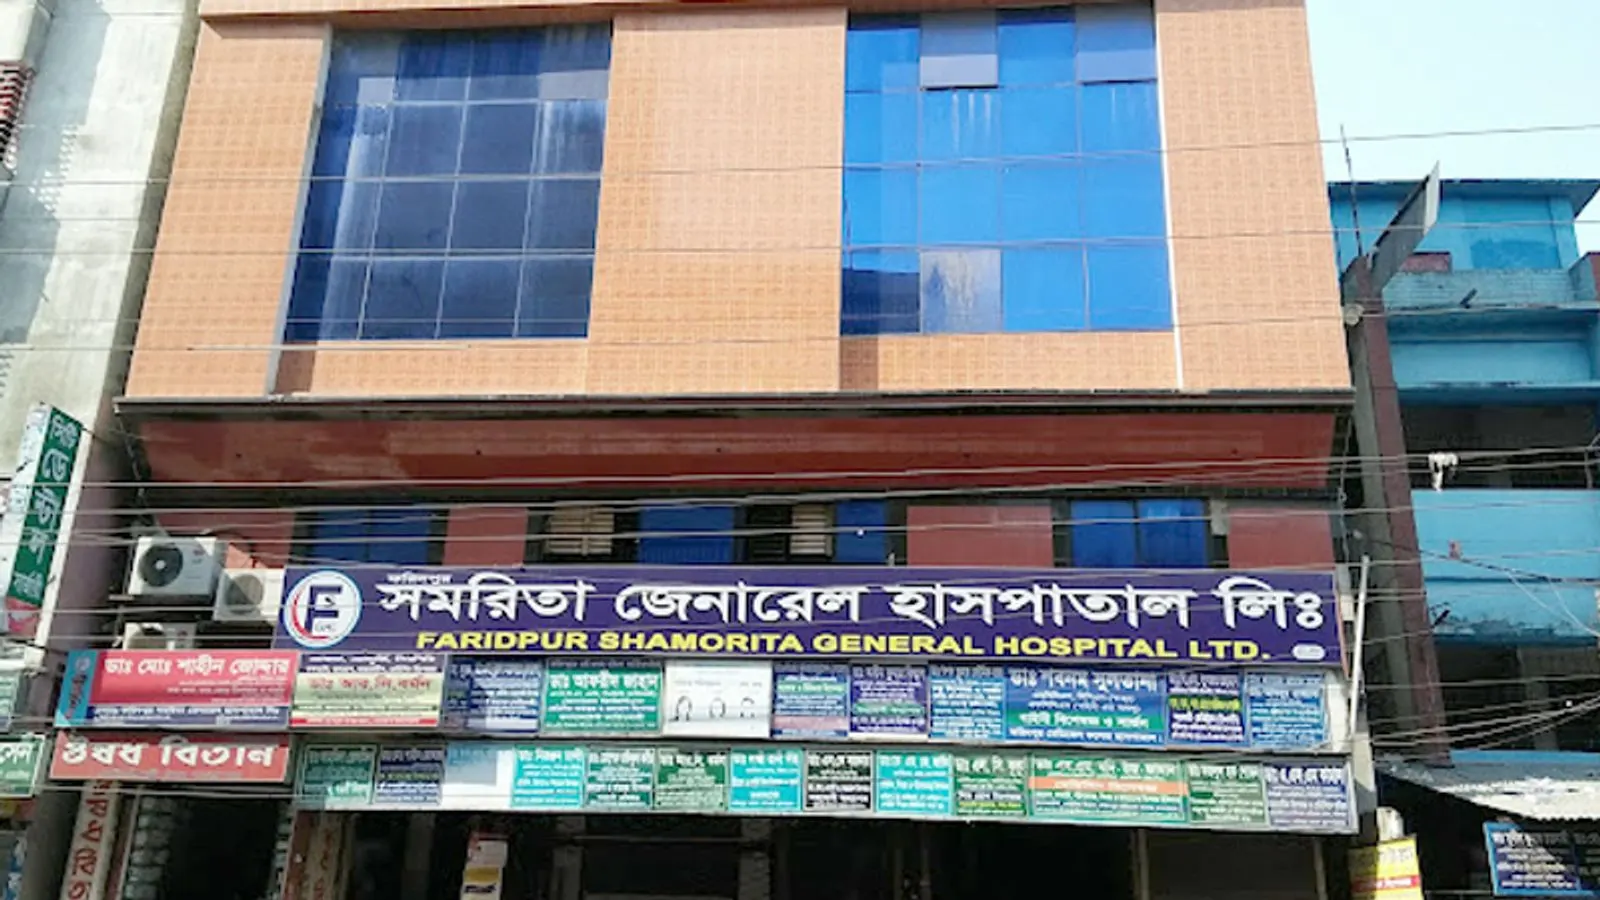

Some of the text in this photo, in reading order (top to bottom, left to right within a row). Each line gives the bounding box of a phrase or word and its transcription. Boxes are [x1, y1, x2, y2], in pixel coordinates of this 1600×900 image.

[375, 574, 1324, 629] সমরিতা জেনারেল হাসপাতাল লিঃ
[416, 631, 589, 650] FARIDPUR
[597, 632, 804, 653] SHAMORITA
[813, 633, 984, 656] GENERAL
[994, 637, 1179, 659] HOSPITAL
[1189, 640, 1270, 661] LTD.
[104, 658, 133, 676] ডাঃ
[137, 658, 173, 676] মোঃ
[176, 653, 226, 676] শাহীন
[160, 736, 276, 768] বিতান
